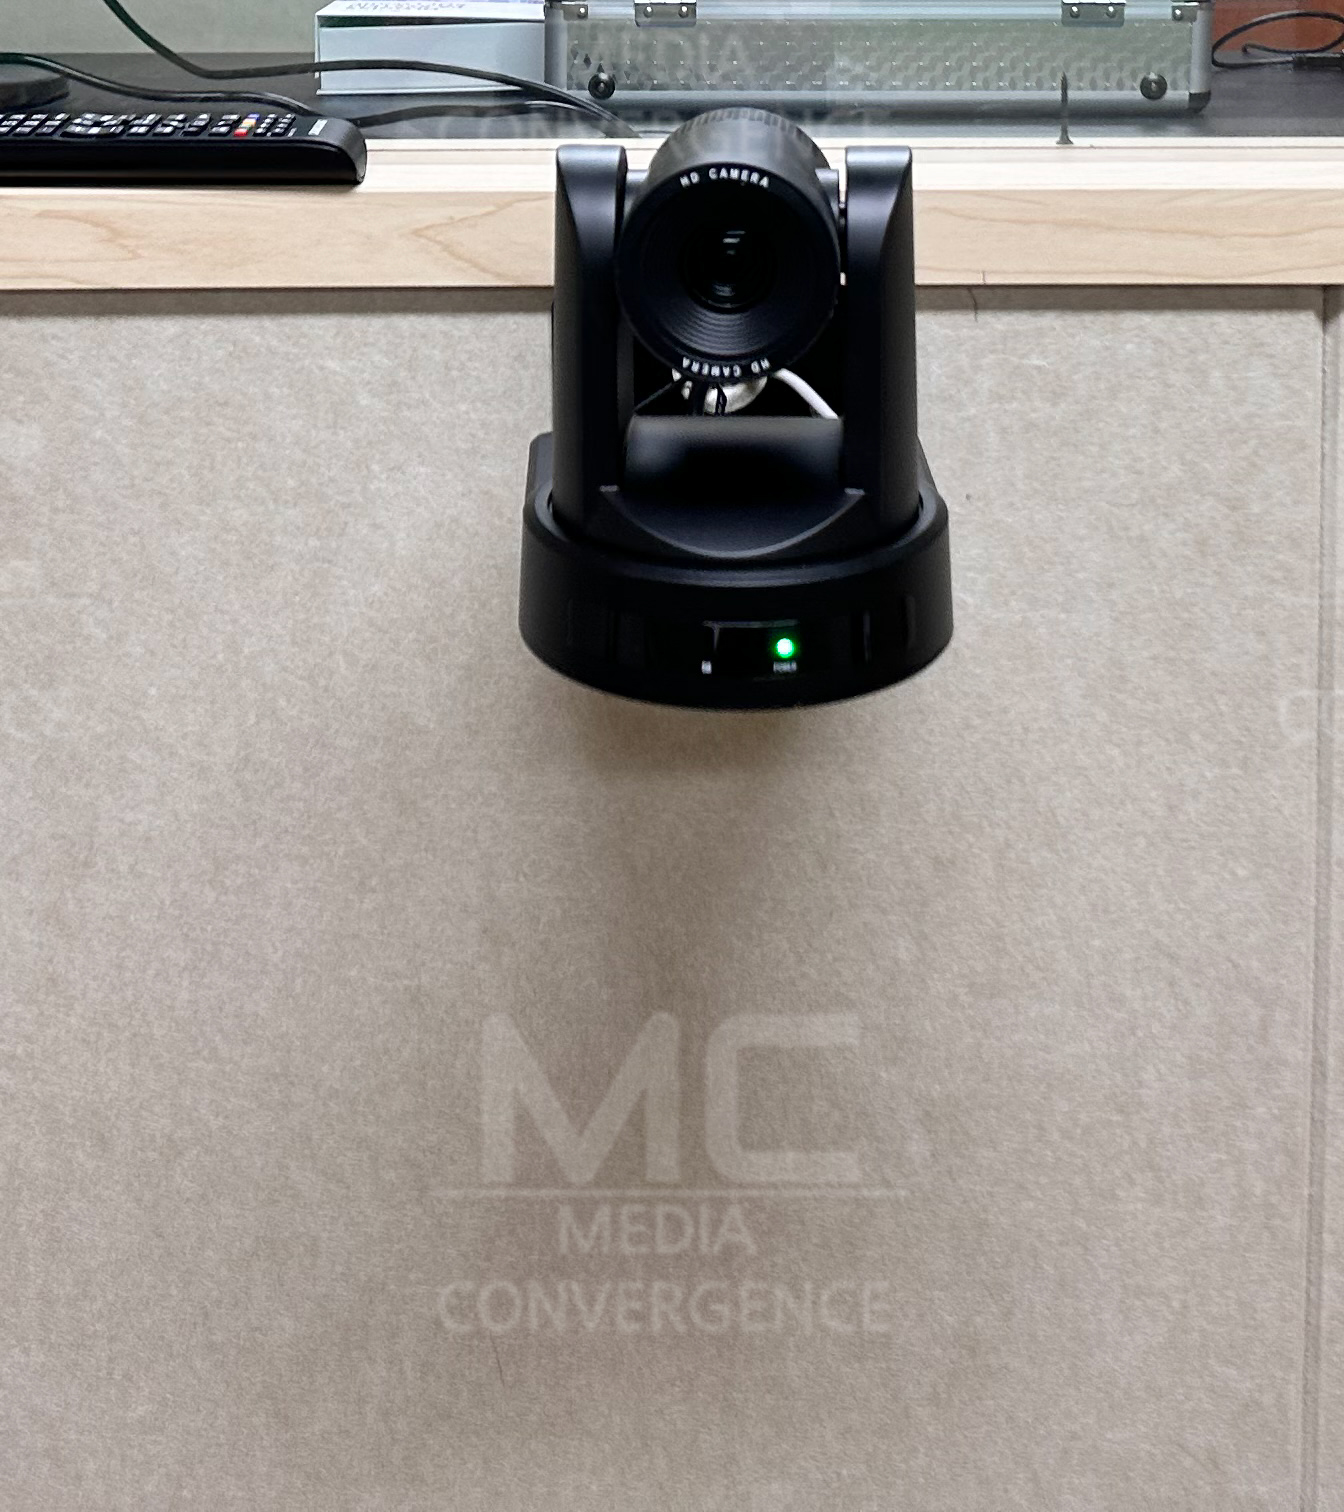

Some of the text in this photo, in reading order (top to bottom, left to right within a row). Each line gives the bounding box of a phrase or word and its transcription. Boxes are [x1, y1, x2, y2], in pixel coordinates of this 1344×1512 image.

[679, 167, 769, 188] HD CAMERA
[682, 356, 771, 378] HD CAMERA
